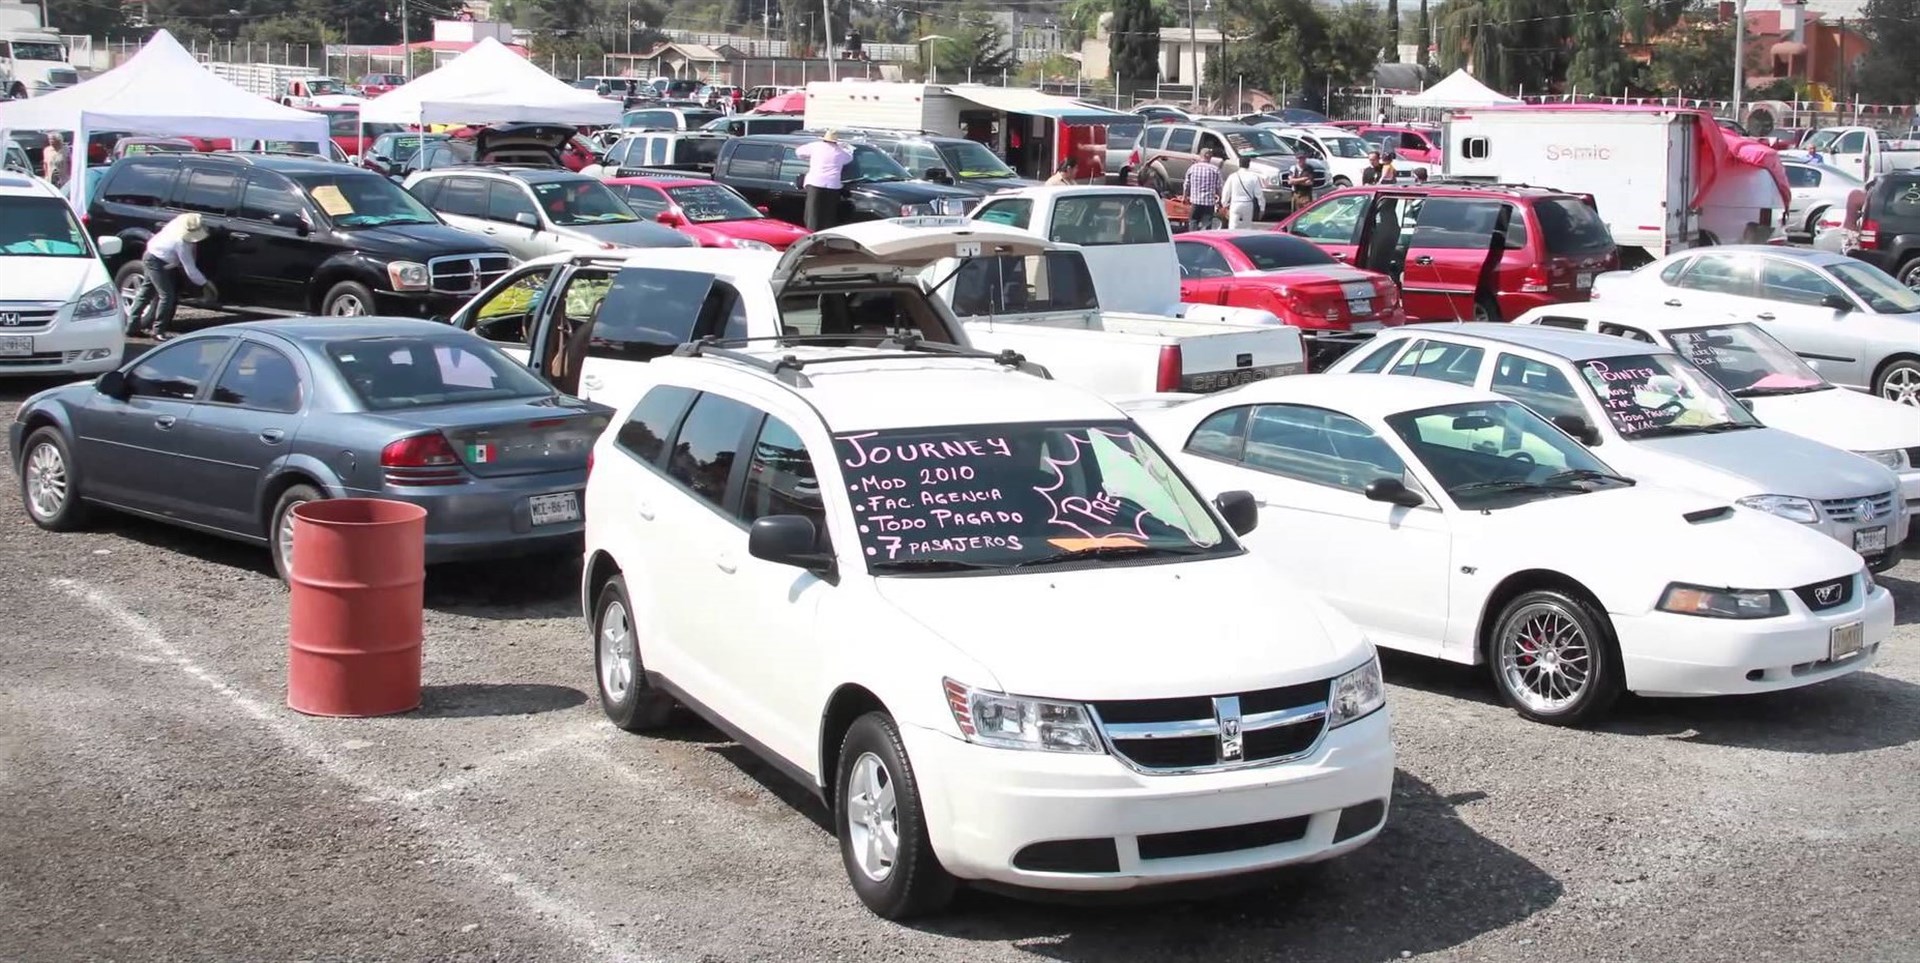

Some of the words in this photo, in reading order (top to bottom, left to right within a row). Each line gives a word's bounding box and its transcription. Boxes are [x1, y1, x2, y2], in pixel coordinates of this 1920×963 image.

[834, 431, 1012, 468] JOURNEY
[861, 475, 906, 493] MOD
[920, 465, 975, 485] 2010
[868, 495, 915, 512] FAC.
[921, 488, 1003, 506] AGENCIA
[868, 515, 926, 532] TODO
[930, 509, 1024, 528] PAGADO
[877, 535, 903, 559] 7
[909, 535, 1024, 555] PASAJEROS
